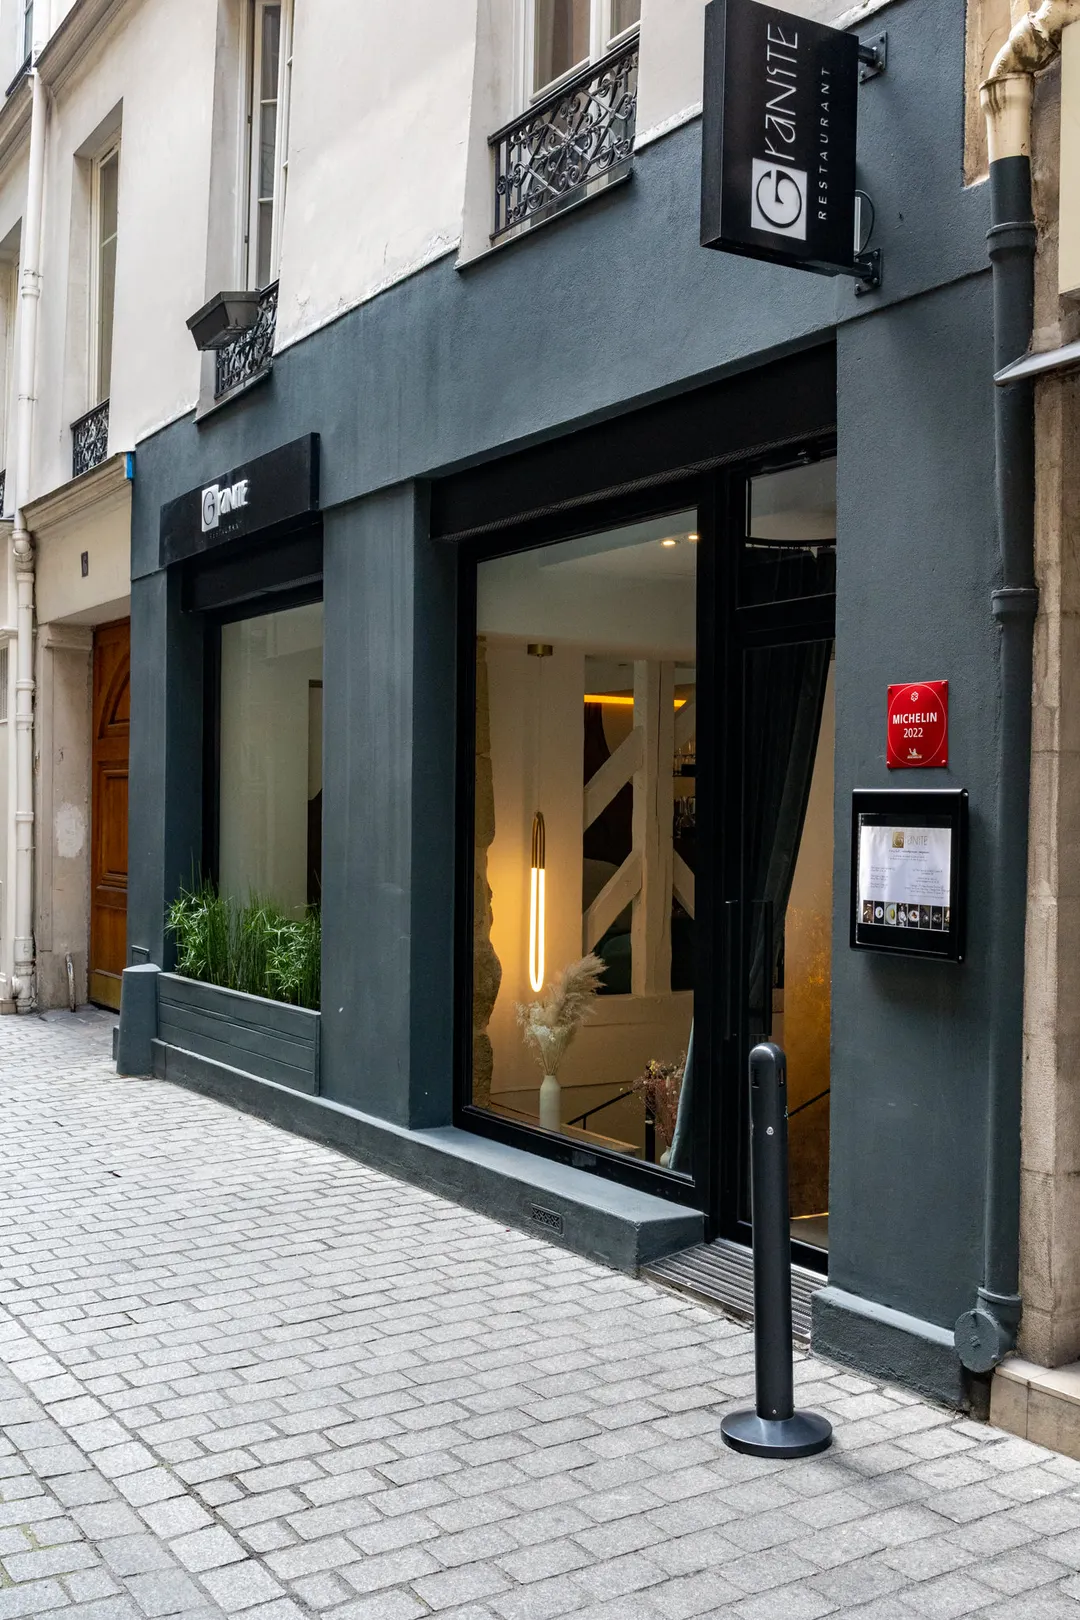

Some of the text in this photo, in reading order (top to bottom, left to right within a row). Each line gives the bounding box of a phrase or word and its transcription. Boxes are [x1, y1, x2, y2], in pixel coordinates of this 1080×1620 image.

[818, 66, 831, 220] RESTAURANT
[892, 712, 938, 725] MICHELIN
[903, 727, 924, 739] 2022
